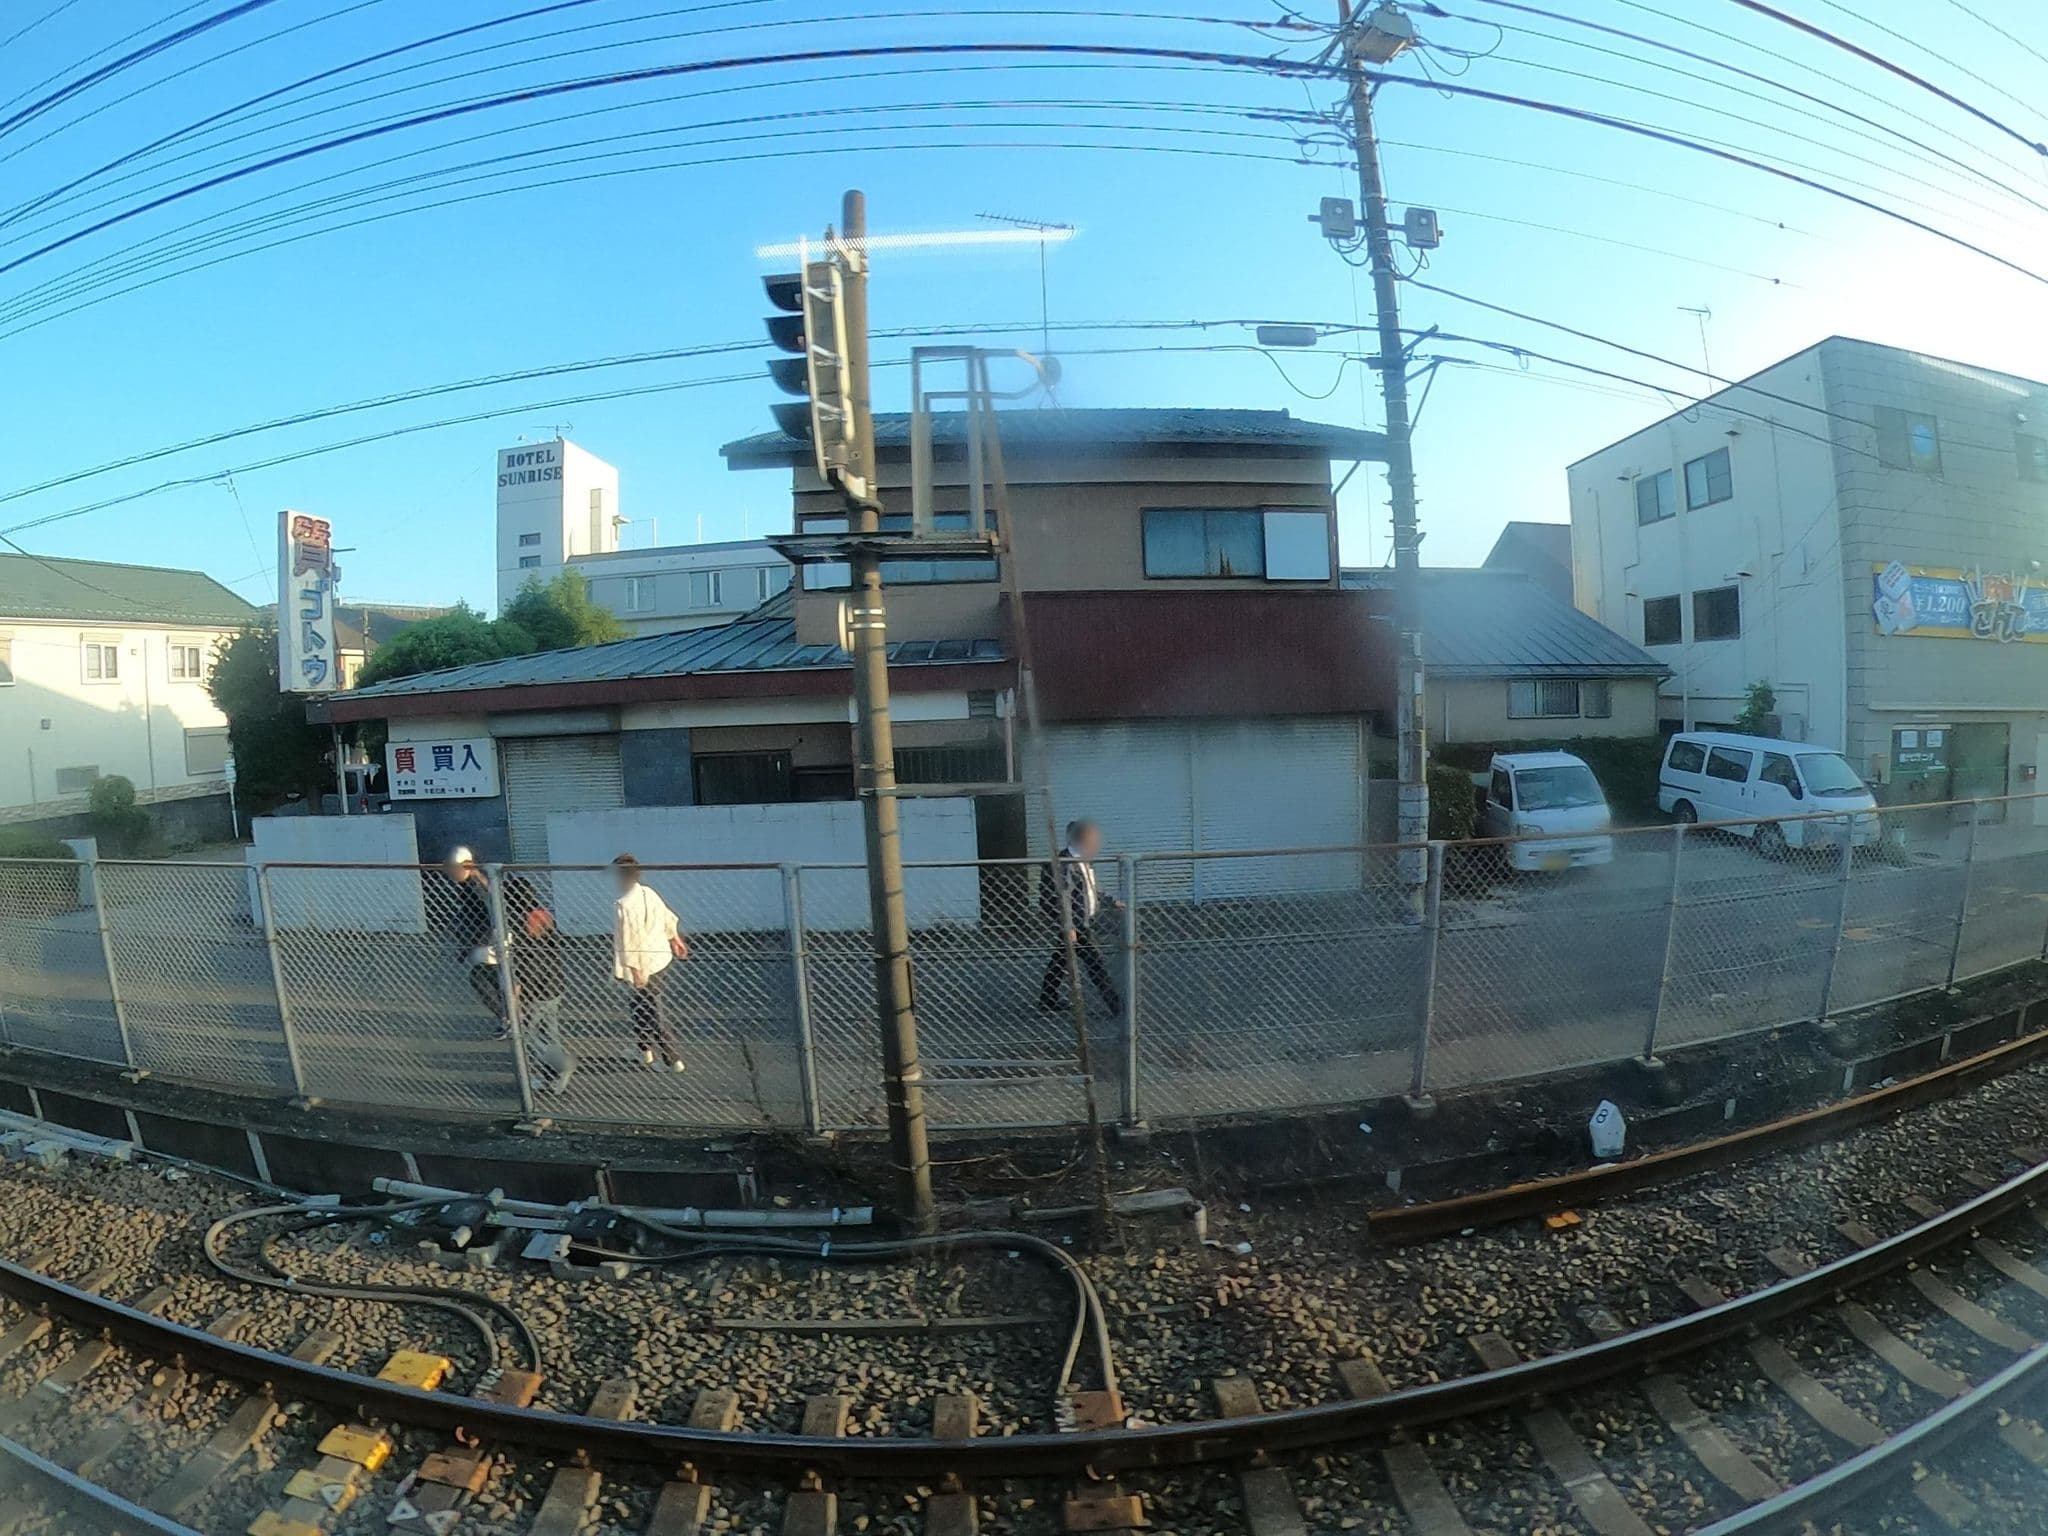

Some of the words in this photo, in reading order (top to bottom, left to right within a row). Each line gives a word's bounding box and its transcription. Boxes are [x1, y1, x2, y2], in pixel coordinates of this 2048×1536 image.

[506, 449, 555, 468] HOTEL
[498, 467, 563, 487] SUNRISE
[394, 747, 417, 774] 質
[431, 744, 482, 772] 買入
[1596, 1108, 1608, 1123] 8
